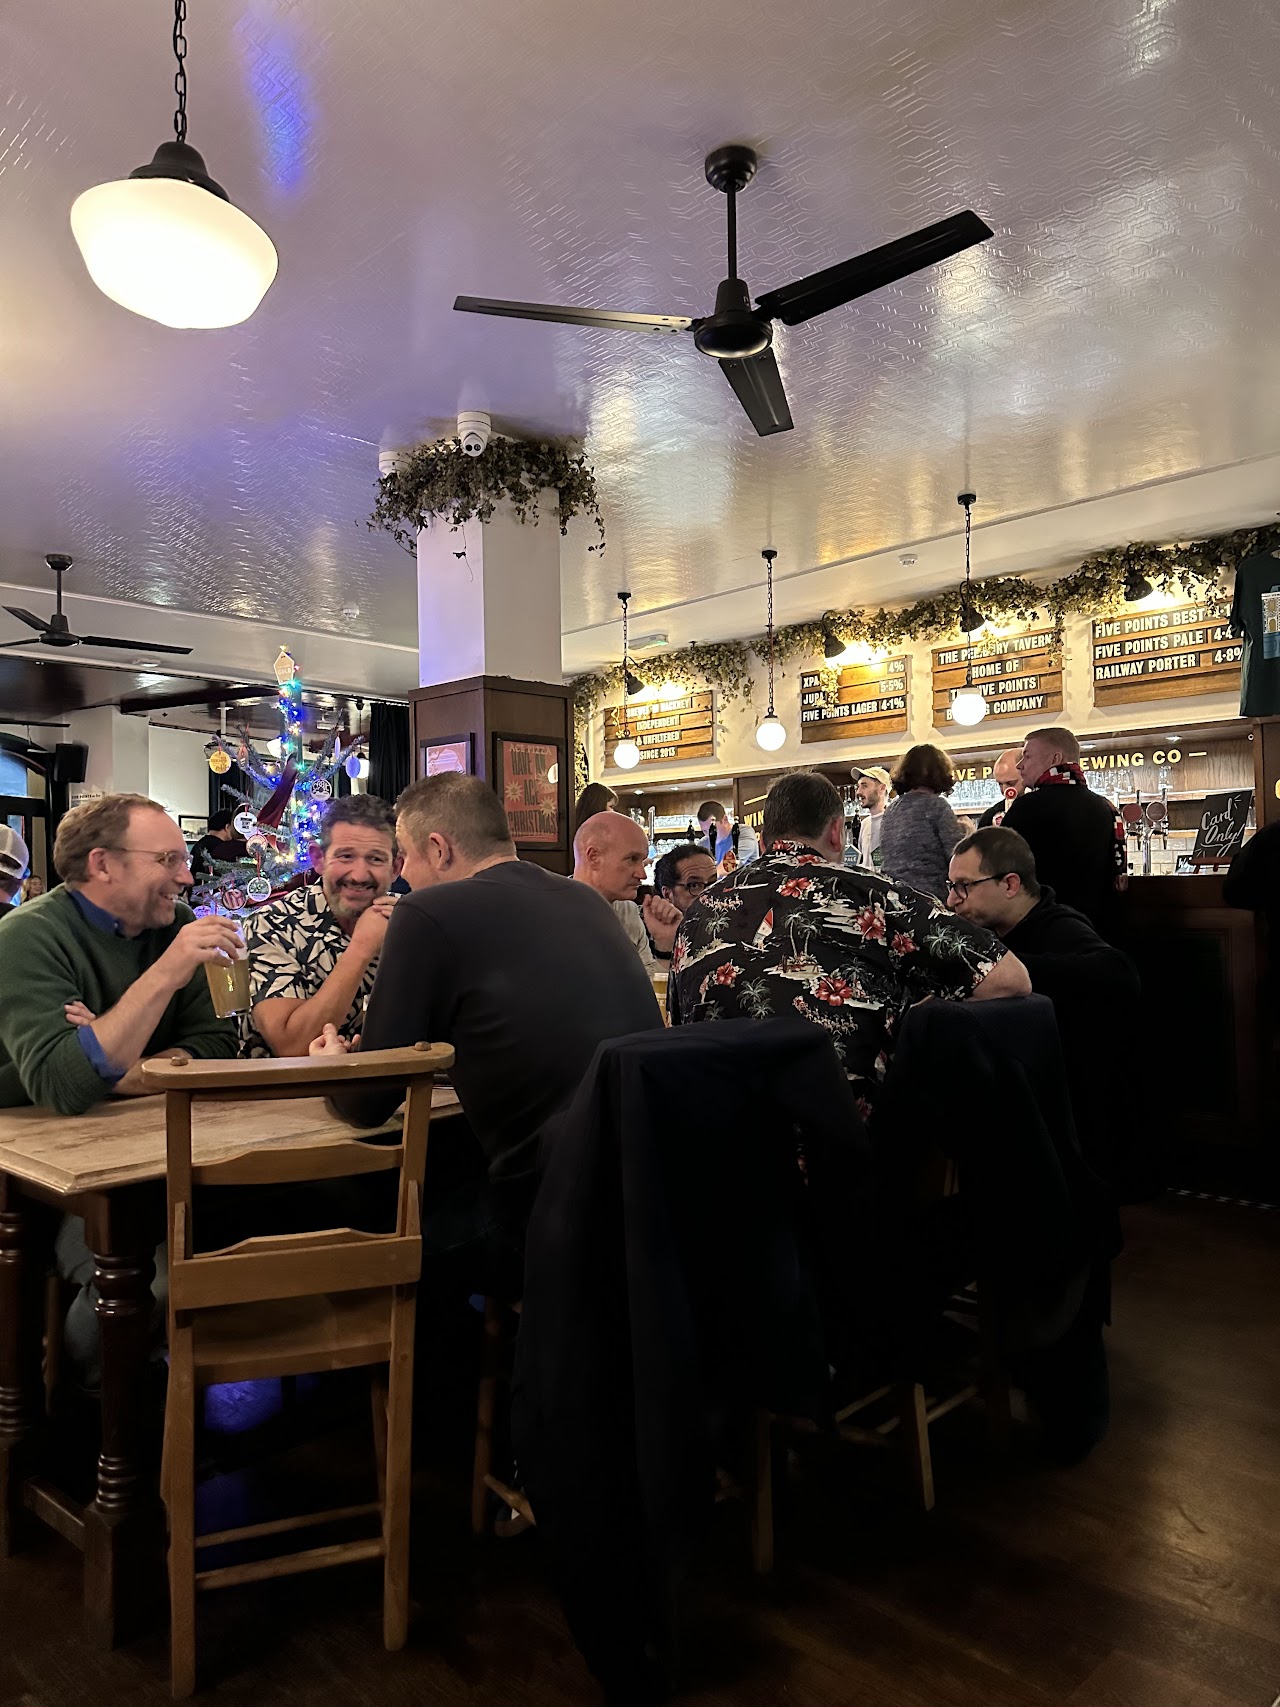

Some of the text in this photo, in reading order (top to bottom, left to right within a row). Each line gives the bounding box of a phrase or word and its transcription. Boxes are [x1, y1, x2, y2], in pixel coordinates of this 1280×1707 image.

[1095, 622, 1121, 639] FIVE
[1125, 615, 1169, 634] POINTS
[1173, 607, 1205, 625] BEST
[939, 650, 959, 665] THE
[1013, 633, 1053, 652] TAVERN
[1095, 643, 1121, 659] FIVE
[1125, 636, 1169, 655] POINTS
[1173, 630, 1204, 648] PALE
[803, 660, 905, 689] XPA 4%
[972, 660, 1020, 679] HOME OF
[1095, 661, 1144, 680] RAILWAY
[1148, 653, 1196, 673] PORTER
[999, 676, 1037, 694] POINTS
[802, 709, 820, 722] FIVE
[821, 706, 850, 720] POINTS
[851, 700, 878, 715] LAGER
[993, 695, 1044, 714] COMPANY
[509, 743, 552, 755] ACE PIZZA
[643, 731, 681, 745] UNFILTERED
[639, 745, 677, 761] SINCE 2013
[1079, 748, 1182, 771] EWING CO
[524, 779, 541, 805] ACE
[1201, 797, 1234, 831] Card
